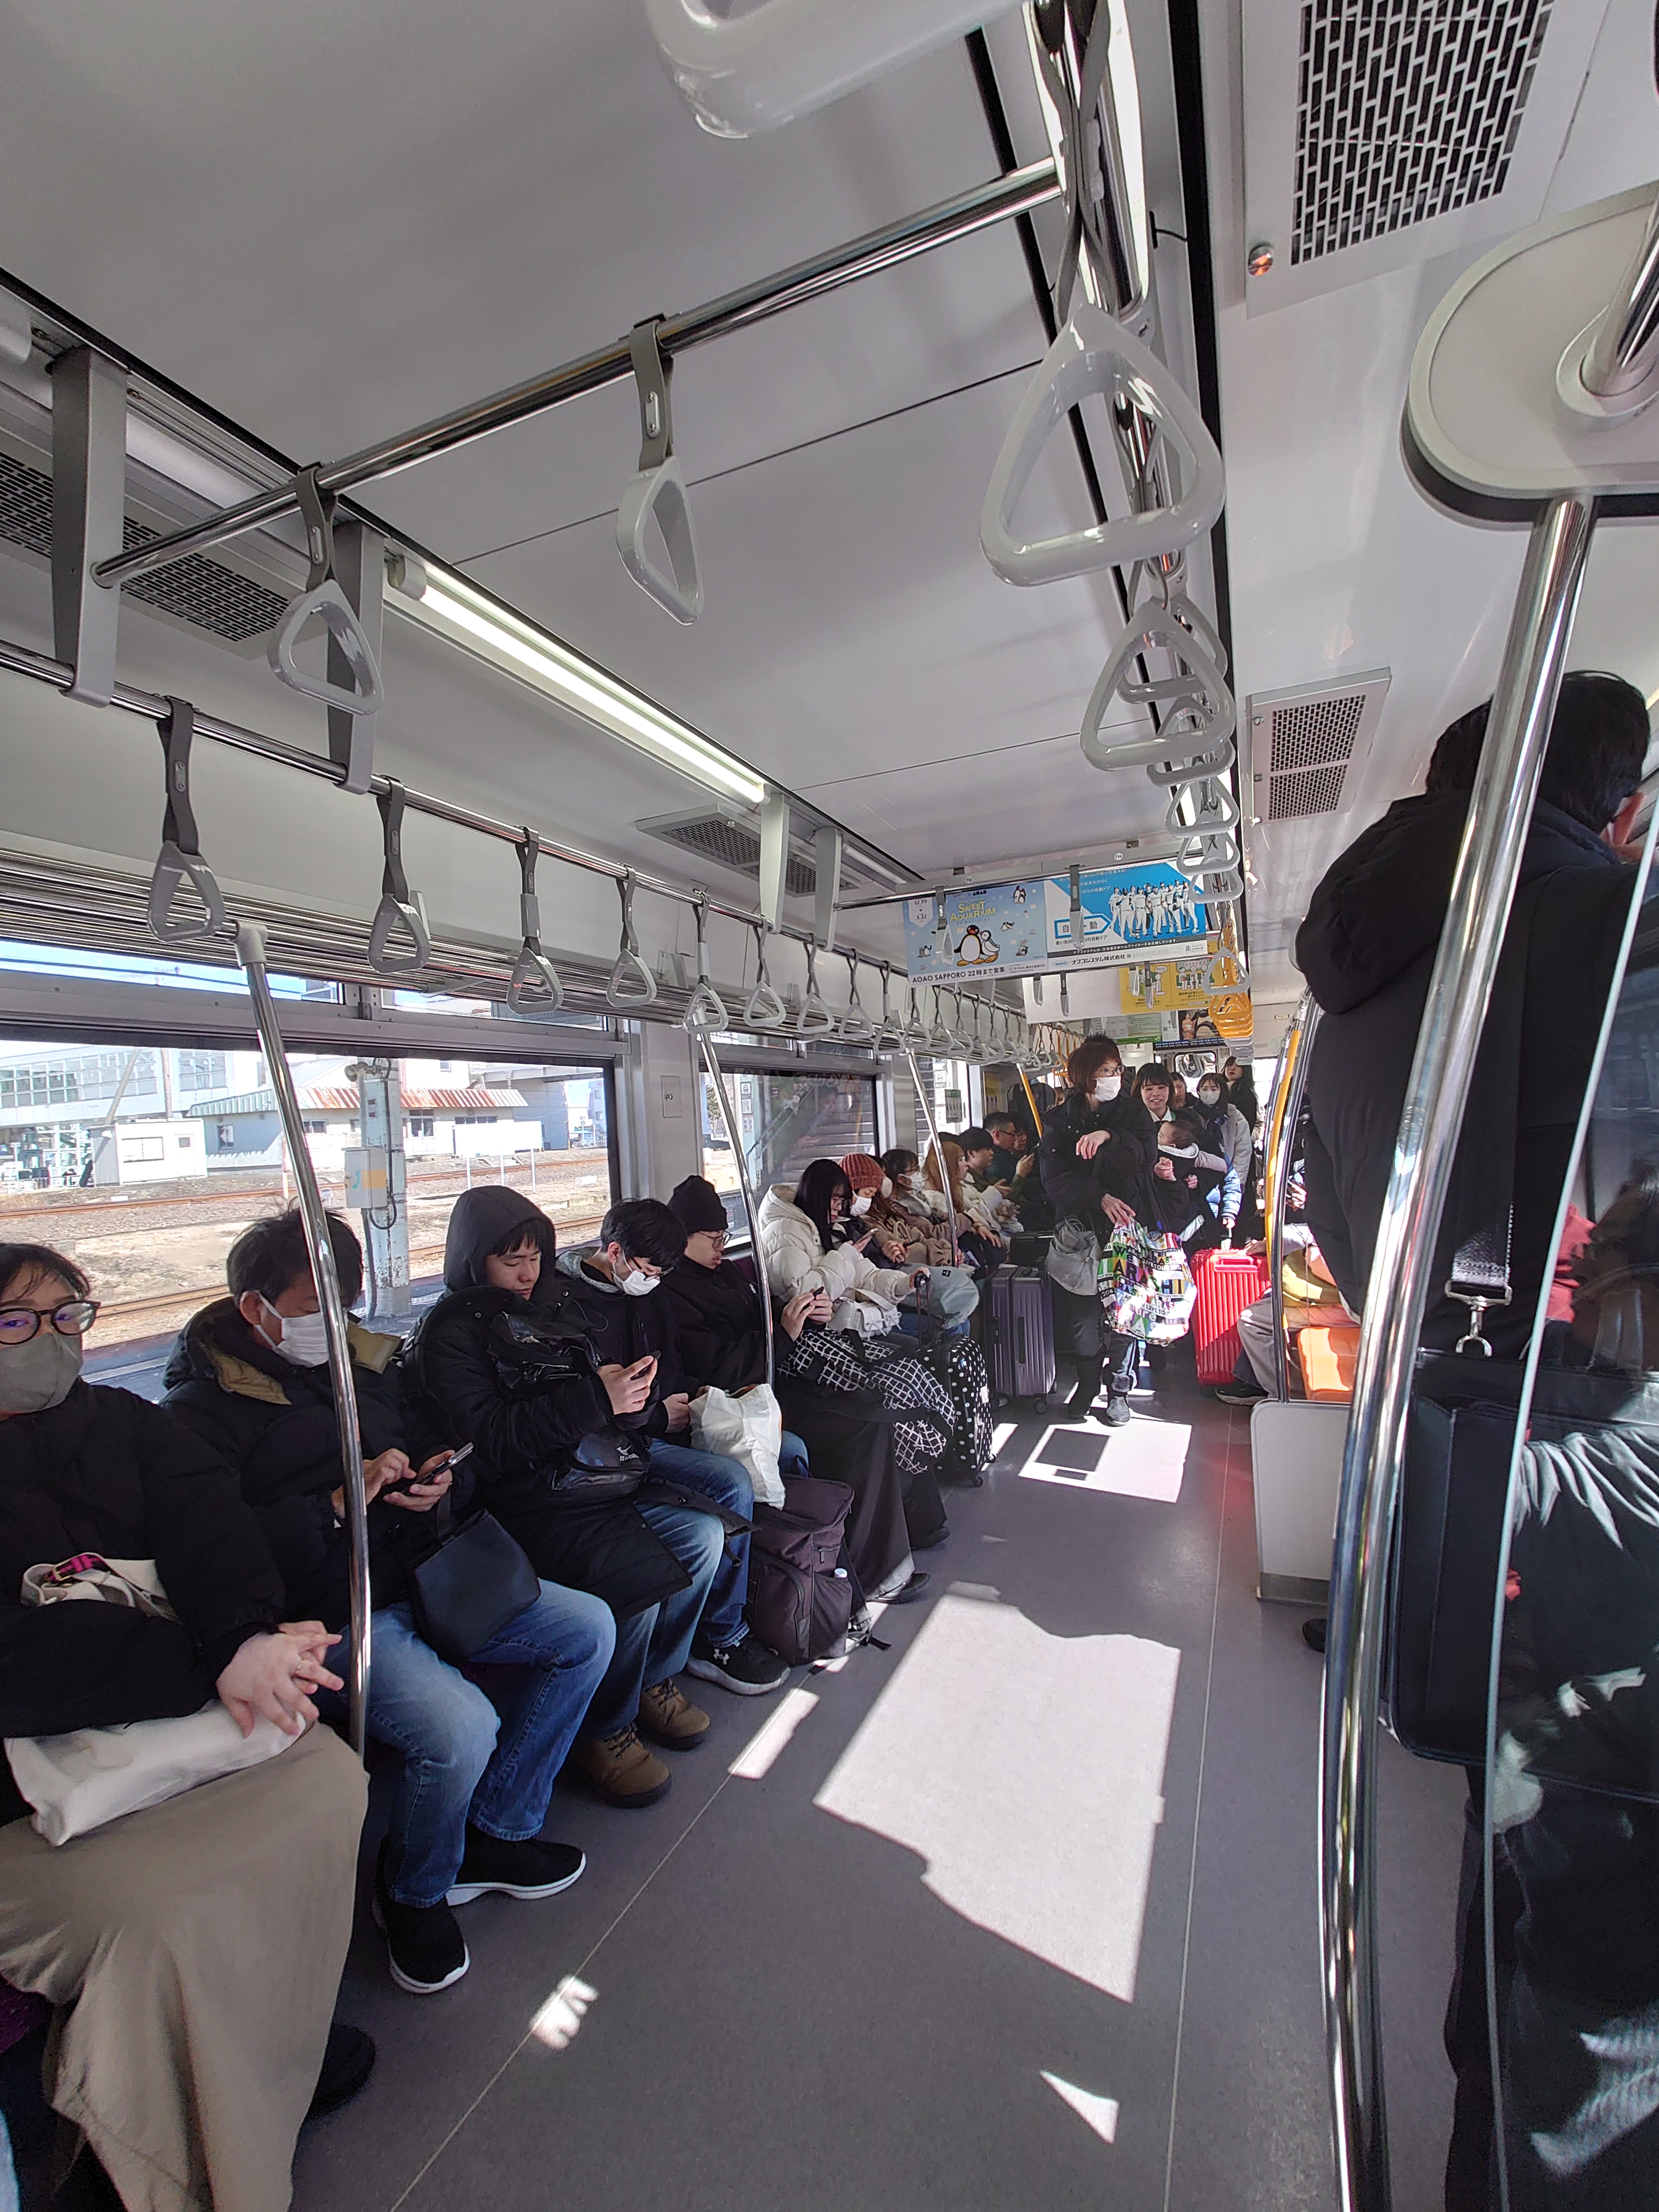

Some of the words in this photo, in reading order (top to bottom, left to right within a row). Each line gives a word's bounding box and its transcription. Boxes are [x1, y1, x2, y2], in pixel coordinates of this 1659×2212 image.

[1090, 921, 1098, 930] 動
[912, 975, 933, 984] AOAO
[935, 971, 966, 981] SAPPORO
[967, 966, 1005, 979] 22時まで営業
